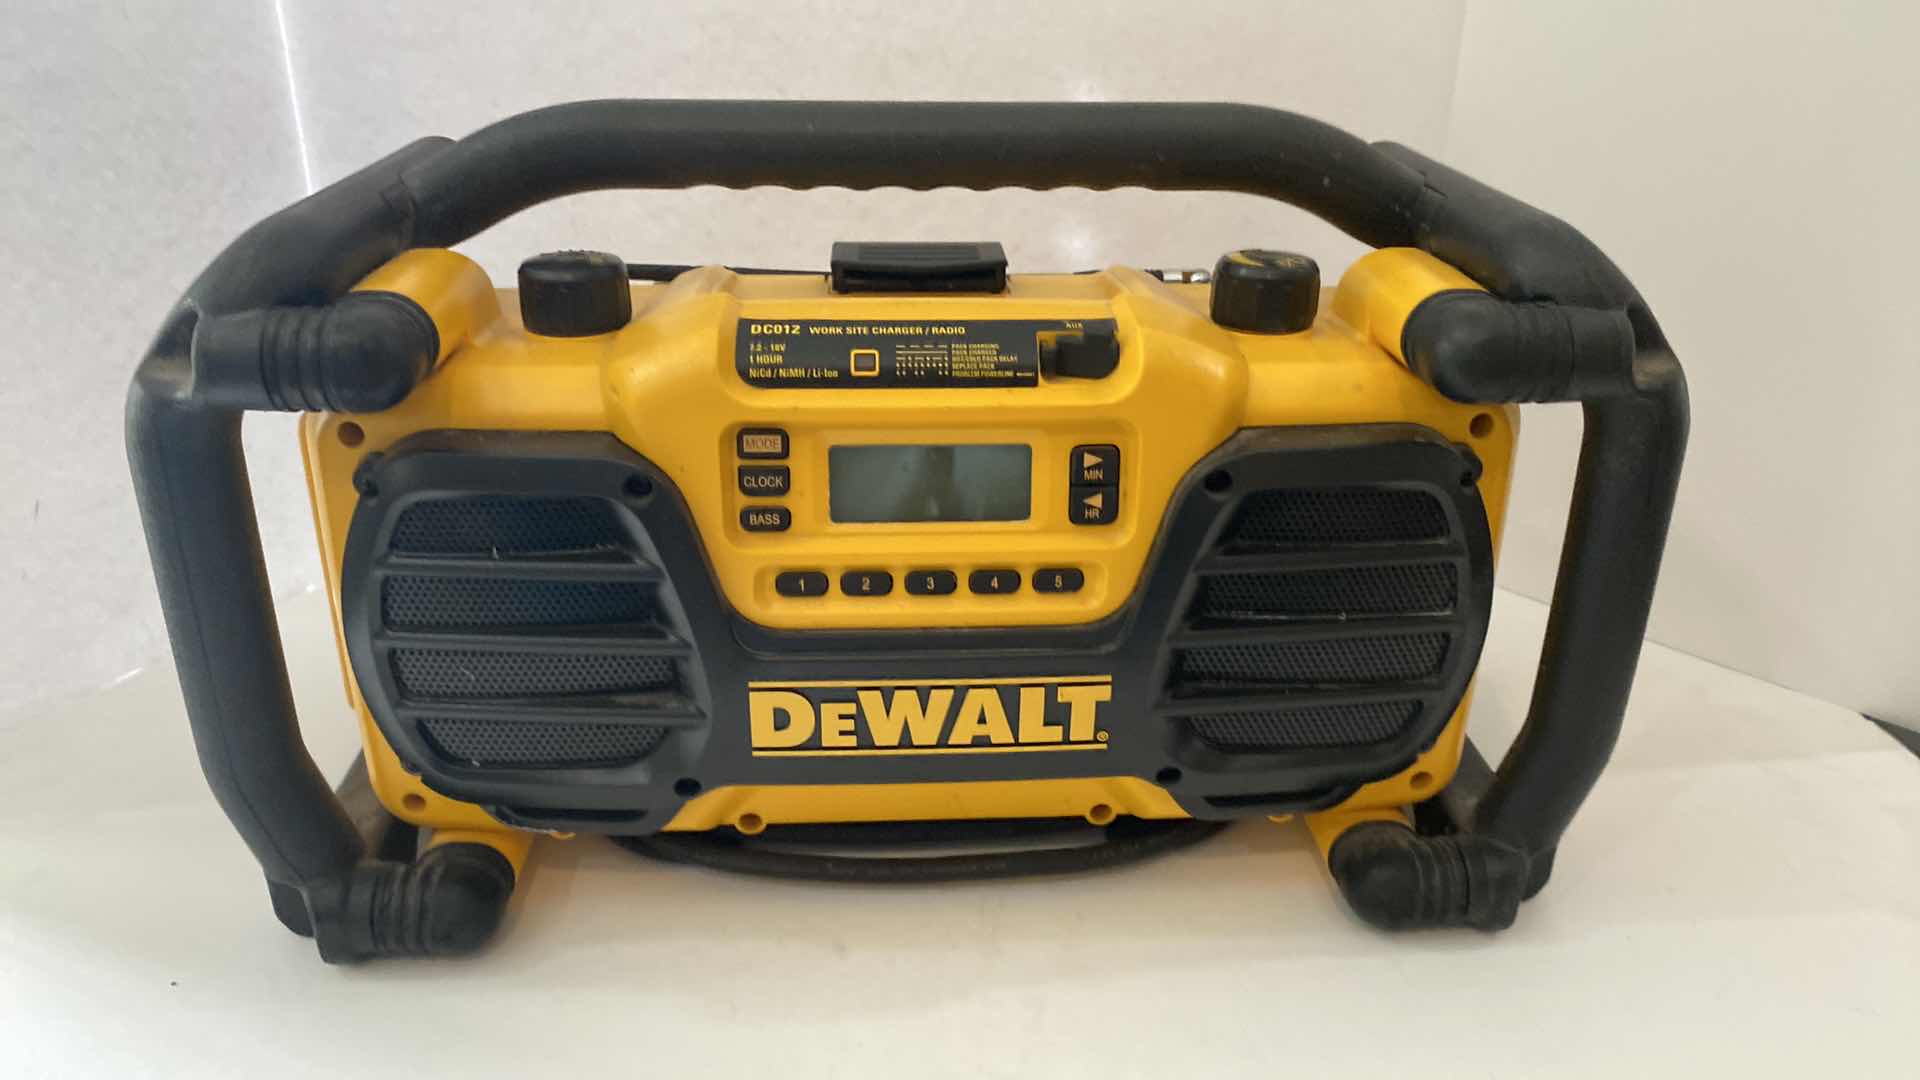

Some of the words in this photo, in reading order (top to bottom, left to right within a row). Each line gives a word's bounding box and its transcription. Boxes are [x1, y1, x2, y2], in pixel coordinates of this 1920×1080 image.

[809, 326, 843, 335] WORK
[846, 326, 868, 335] SITE
[872, 326, 923, 336] CHARGER
[931, 326, 966, 335] RADIO
[757, 354, 783, 364] HOUR
[749, 368, 771, 377] NiCd
[779, 368, 805, 377] NiMH
[745, 437, 779, 449] MODE
[1084, 470, 1103, 480] MIN
[743, 475, 784, 488] CLOCK
[749, 513, 781, 525] BASS
[1085, 508, 1100, 519] HR
[798, 579, 805, 592] 1
[861, 577, 871, 590] 2
[926, 576, 935, 590] 3
[990, 576, 999, 589] 4
[1055, 576, 1063, 589] 5
